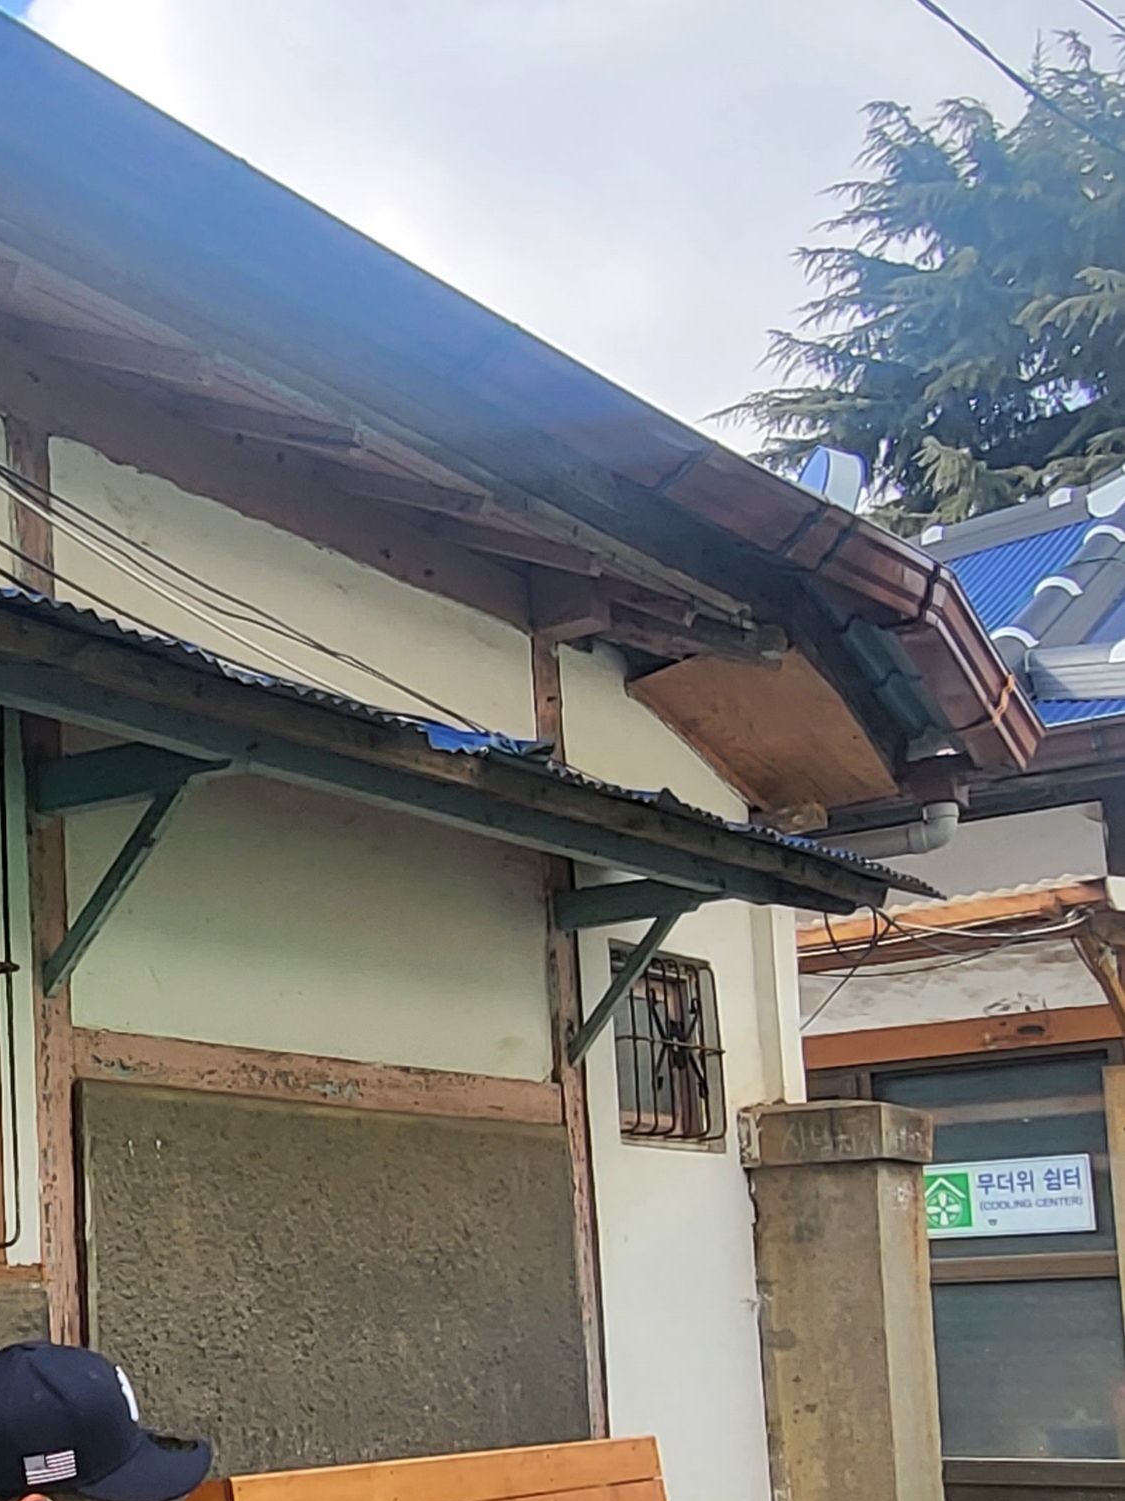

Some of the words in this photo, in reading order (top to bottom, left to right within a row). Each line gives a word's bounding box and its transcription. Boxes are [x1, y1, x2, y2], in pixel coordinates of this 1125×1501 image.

[976, 1169, 1034, 1196] 무더위
[1043, 1166, 1081, 1191] 쉼터
[979, 1199, 1032, 1212] (COOLING
[1035, 1196, 1083, 1208] CENTER)
